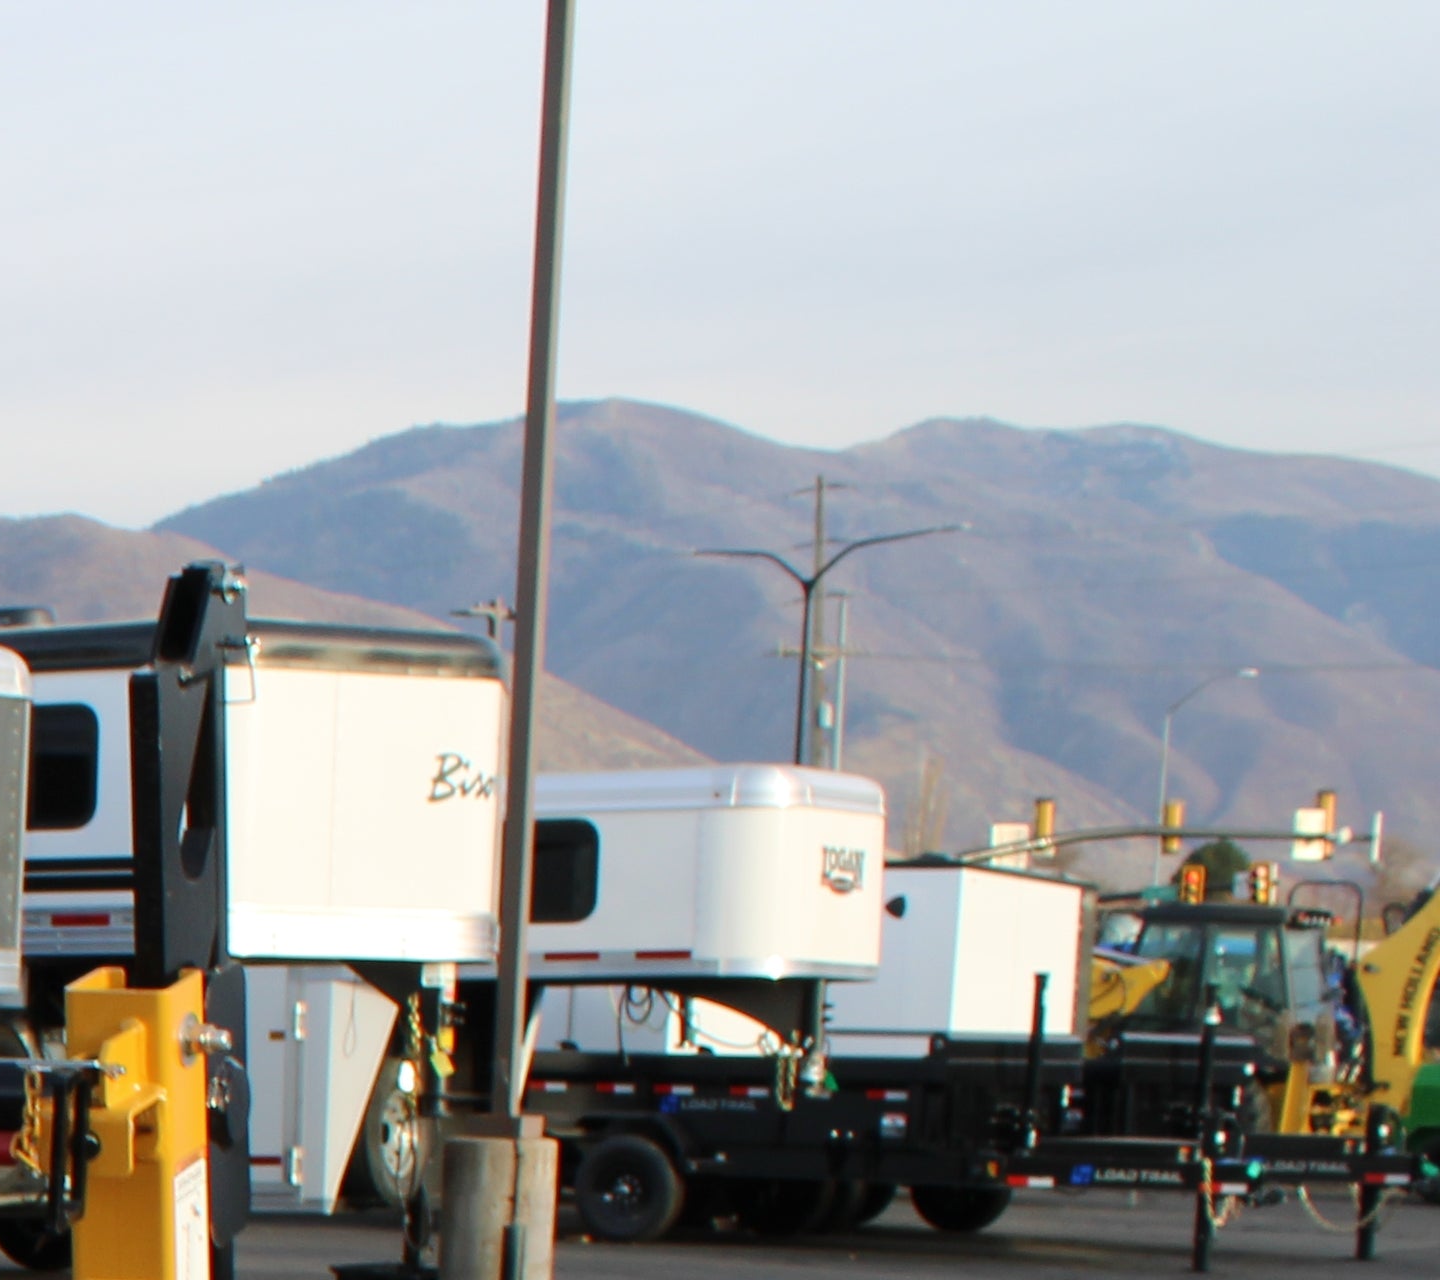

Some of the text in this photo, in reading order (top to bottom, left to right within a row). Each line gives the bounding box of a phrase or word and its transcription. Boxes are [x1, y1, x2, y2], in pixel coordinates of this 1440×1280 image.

[1393, 1012, 1412, 1057] NEW
[1093, 1168, 1184, 1184] LOAD TRAIL
